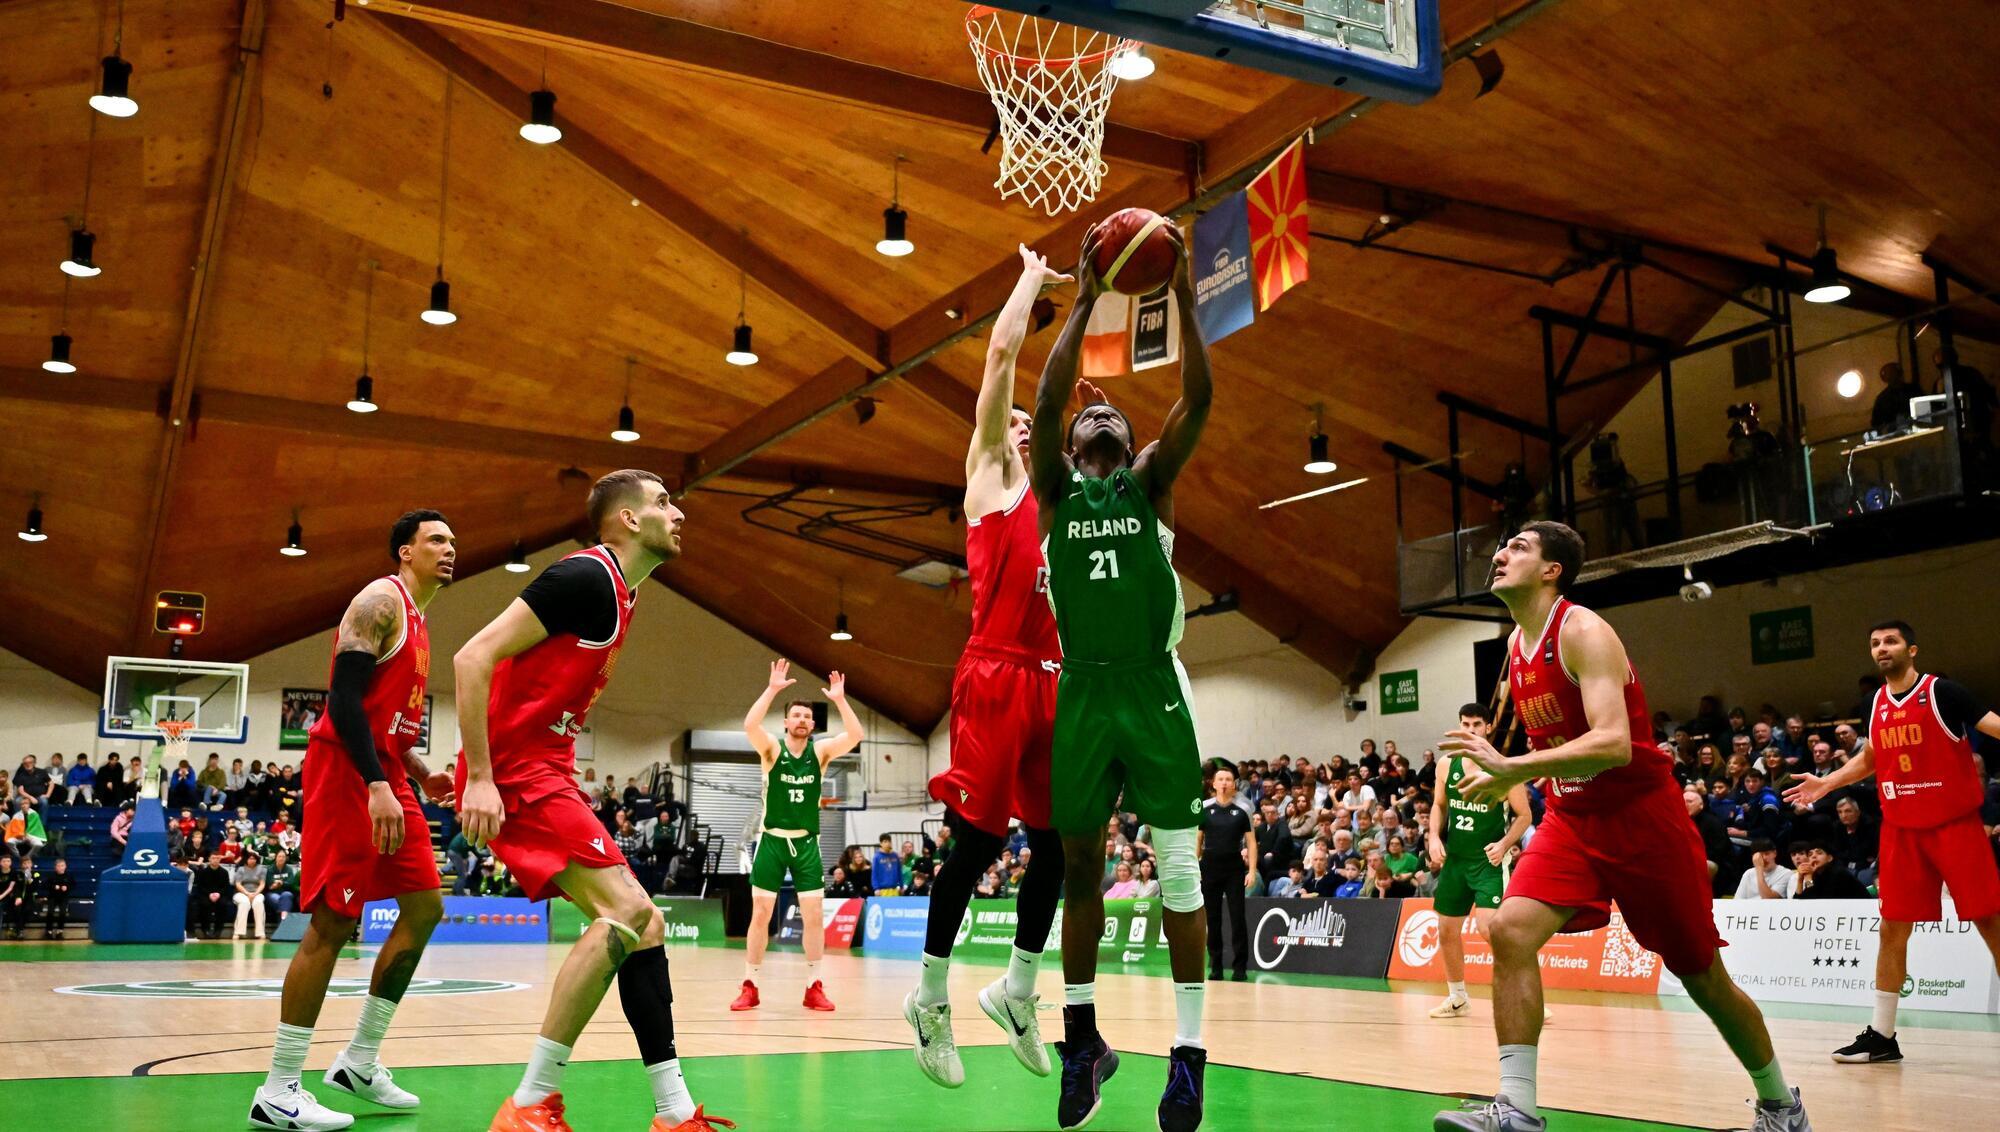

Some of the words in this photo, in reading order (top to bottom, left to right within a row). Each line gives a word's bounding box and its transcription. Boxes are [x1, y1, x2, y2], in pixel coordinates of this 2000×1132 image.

[1196, 256, 1247, 295] EUROBASKET
[1141, 310, 1163, 333] FIBA
[1068, 517, 1141, 539] RELAND
[1089, 549, 1119, 580] 21
[1398, 679, 1413, 687] EAST
[287, 692, 322, 701] NEVER
[1396, 686, 1416, 696] STAND
[1880, 724, 1923, 750] MKD
[1898, 754, 1912, 773] 8
[788, 789, 805, 803] 13
[1455, 815, 1474, 831] 22
[1725, 916, 1760, 931] THE
[1768, 917, 1827, 932] LOUIS
[1813, 938, 1862, 951] HOTEL
[1769, 976, 1808, 988] HOTEL
[1811, 978, 1866, 990] PARTNER
[1918, 979, 1966, 989] Basketball
[1917, 988, 1948, 997] Ireland
